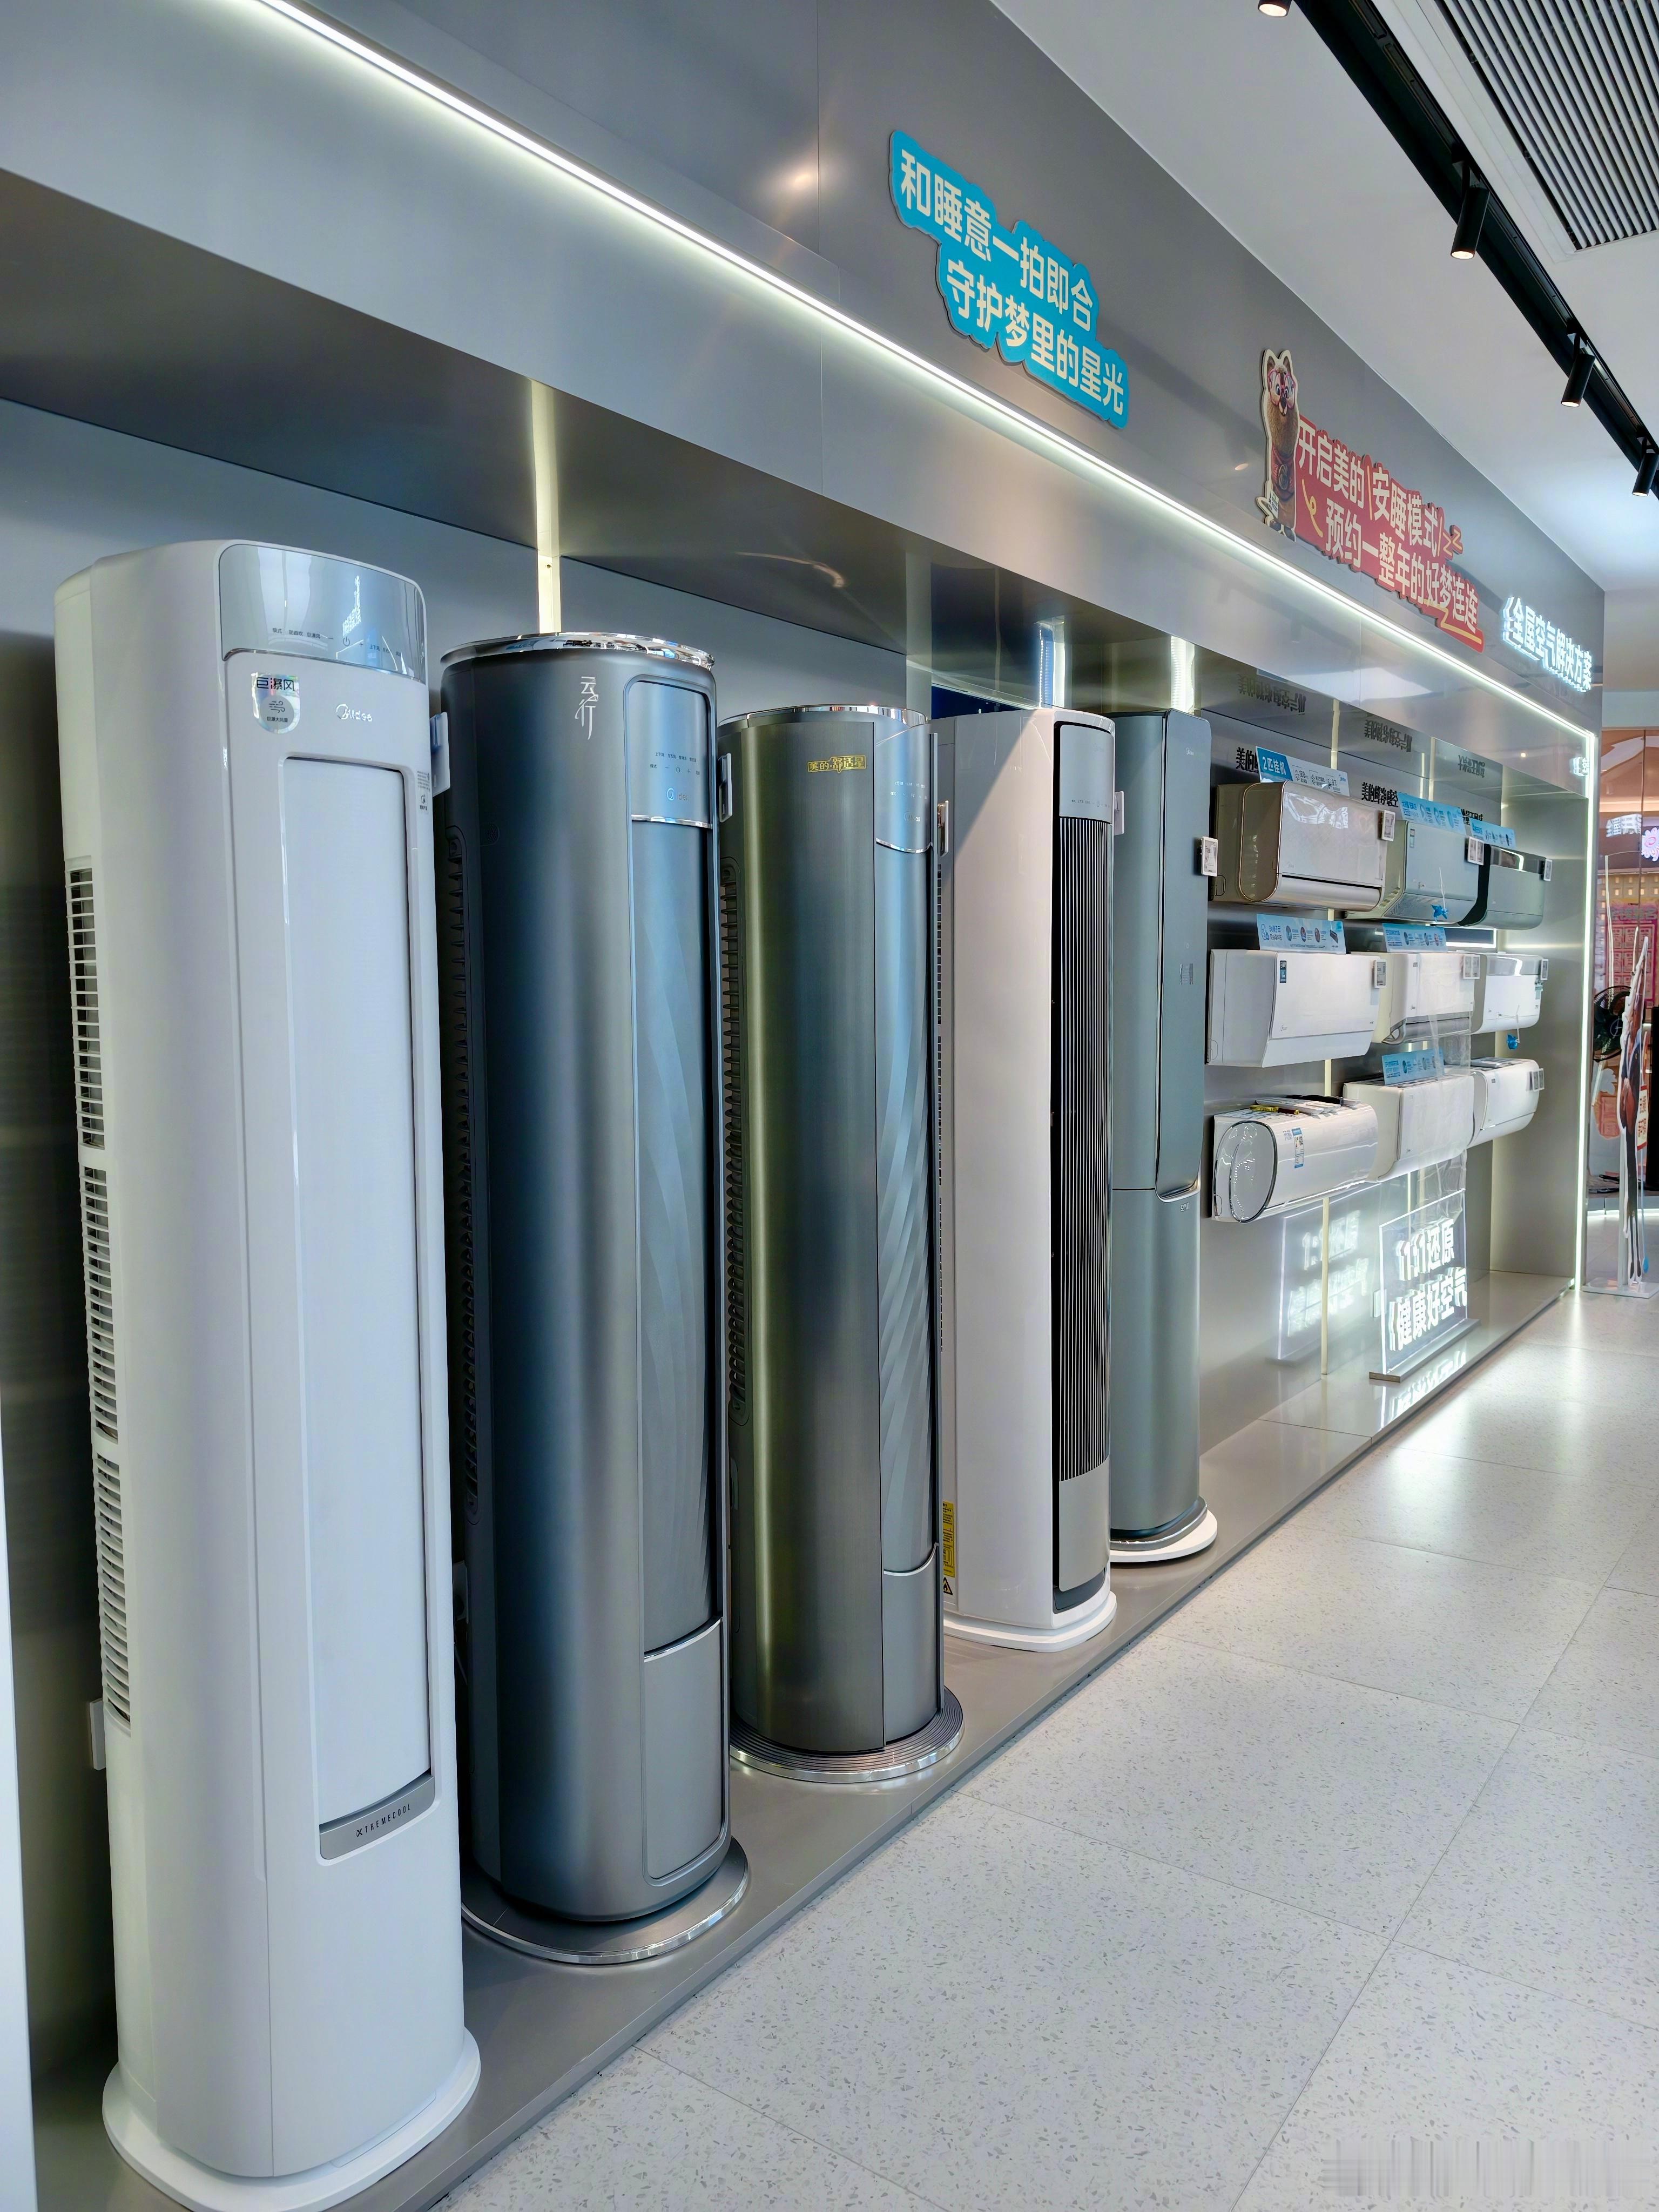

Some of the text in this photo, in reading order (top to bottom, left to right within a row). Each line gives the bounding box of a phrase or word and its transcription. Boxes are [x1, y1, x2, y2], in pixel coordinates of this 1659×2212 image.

[901, 149, 1093, 332] 和睡意一拍即合
[947, 259, 1124, 415] 守护梦里的星光
[1326, 497, 1478, 634] 预约一整年的好梦连连
[1503, 597, 1592, 691] 全屋空气解决方案
[257, 677, 295, 691] 巨瀑风
[336, 704, 373, 722] Midea
[575, 676, 599, 740] 云行
[1262, 756, 1286, 775] 2匹挂机
[1390, 1267, 1467, 1351] 健康好空气
[356, 1804, 410, 1837] XTREMECOOL
